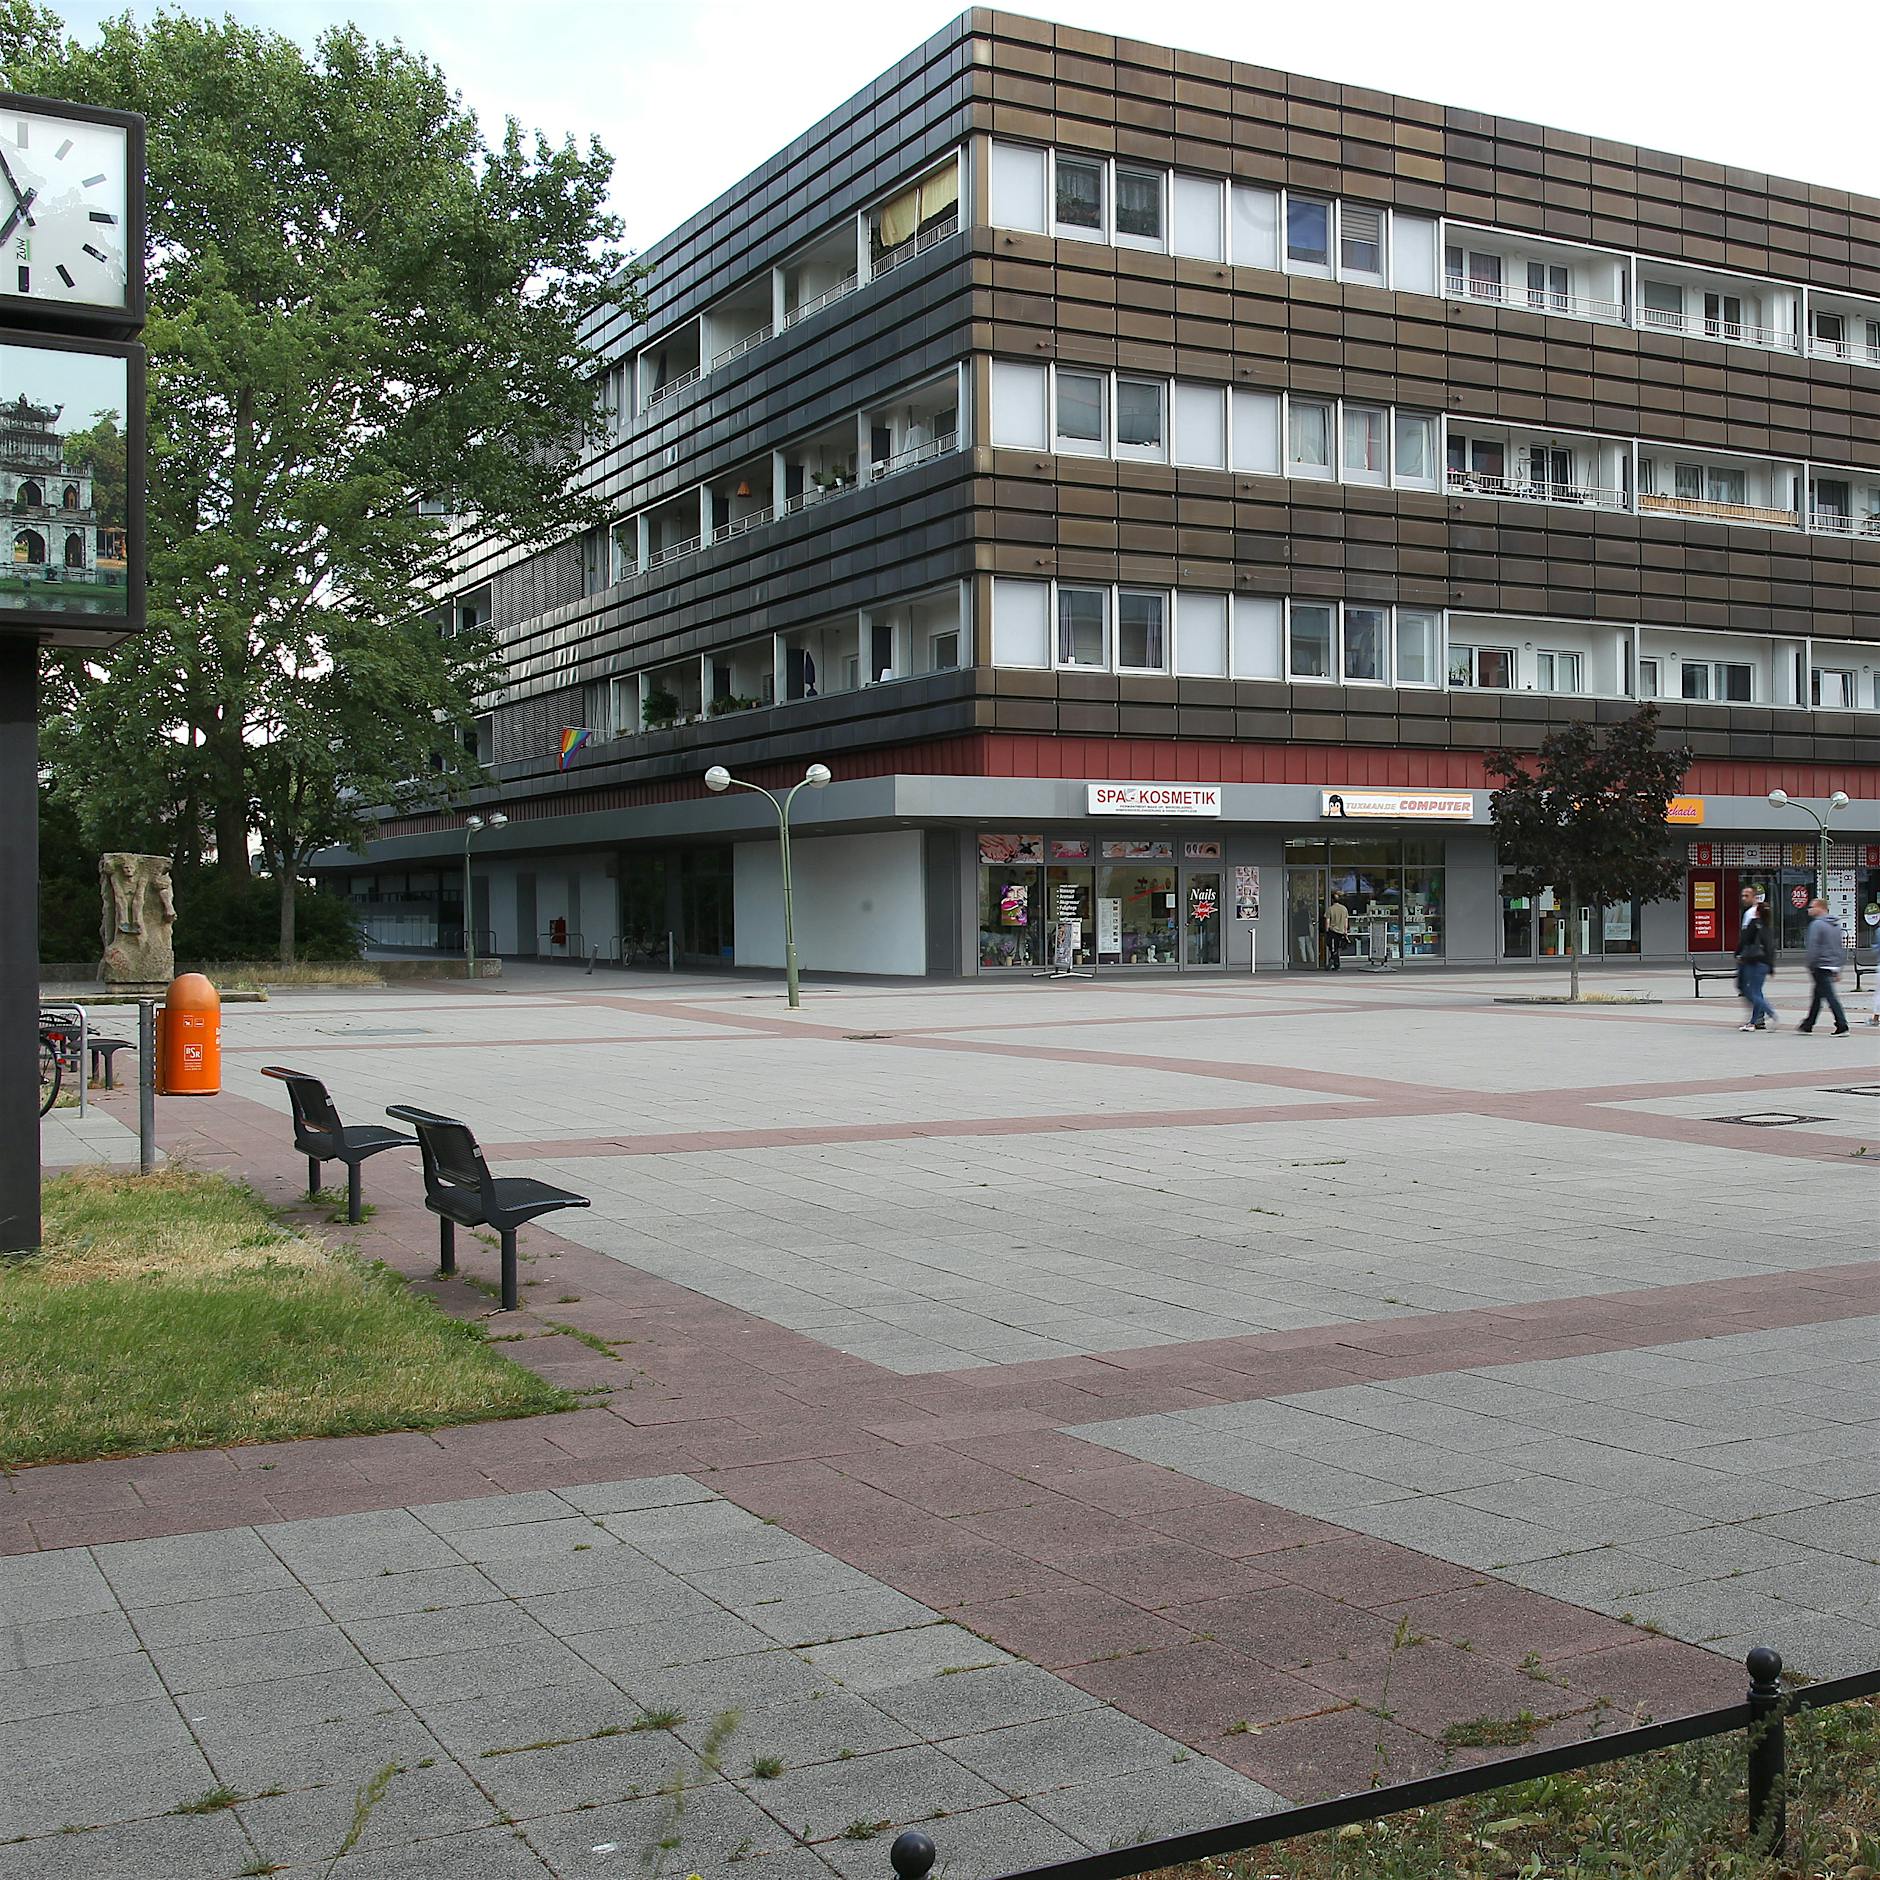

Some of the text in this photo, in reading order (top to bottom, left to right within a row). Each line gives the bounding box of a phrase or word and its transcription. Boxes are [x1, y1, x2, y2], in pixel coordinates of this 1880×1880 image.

[1097, 790, 1126, 803] SPA
[1139, 790, 1215, 805] KOSMETIK
[1400, 800, 1470, 811] COMPUTER
[1190, 888, 1216, 900] Nails
[185, 1046, 201, 1059] BSR
